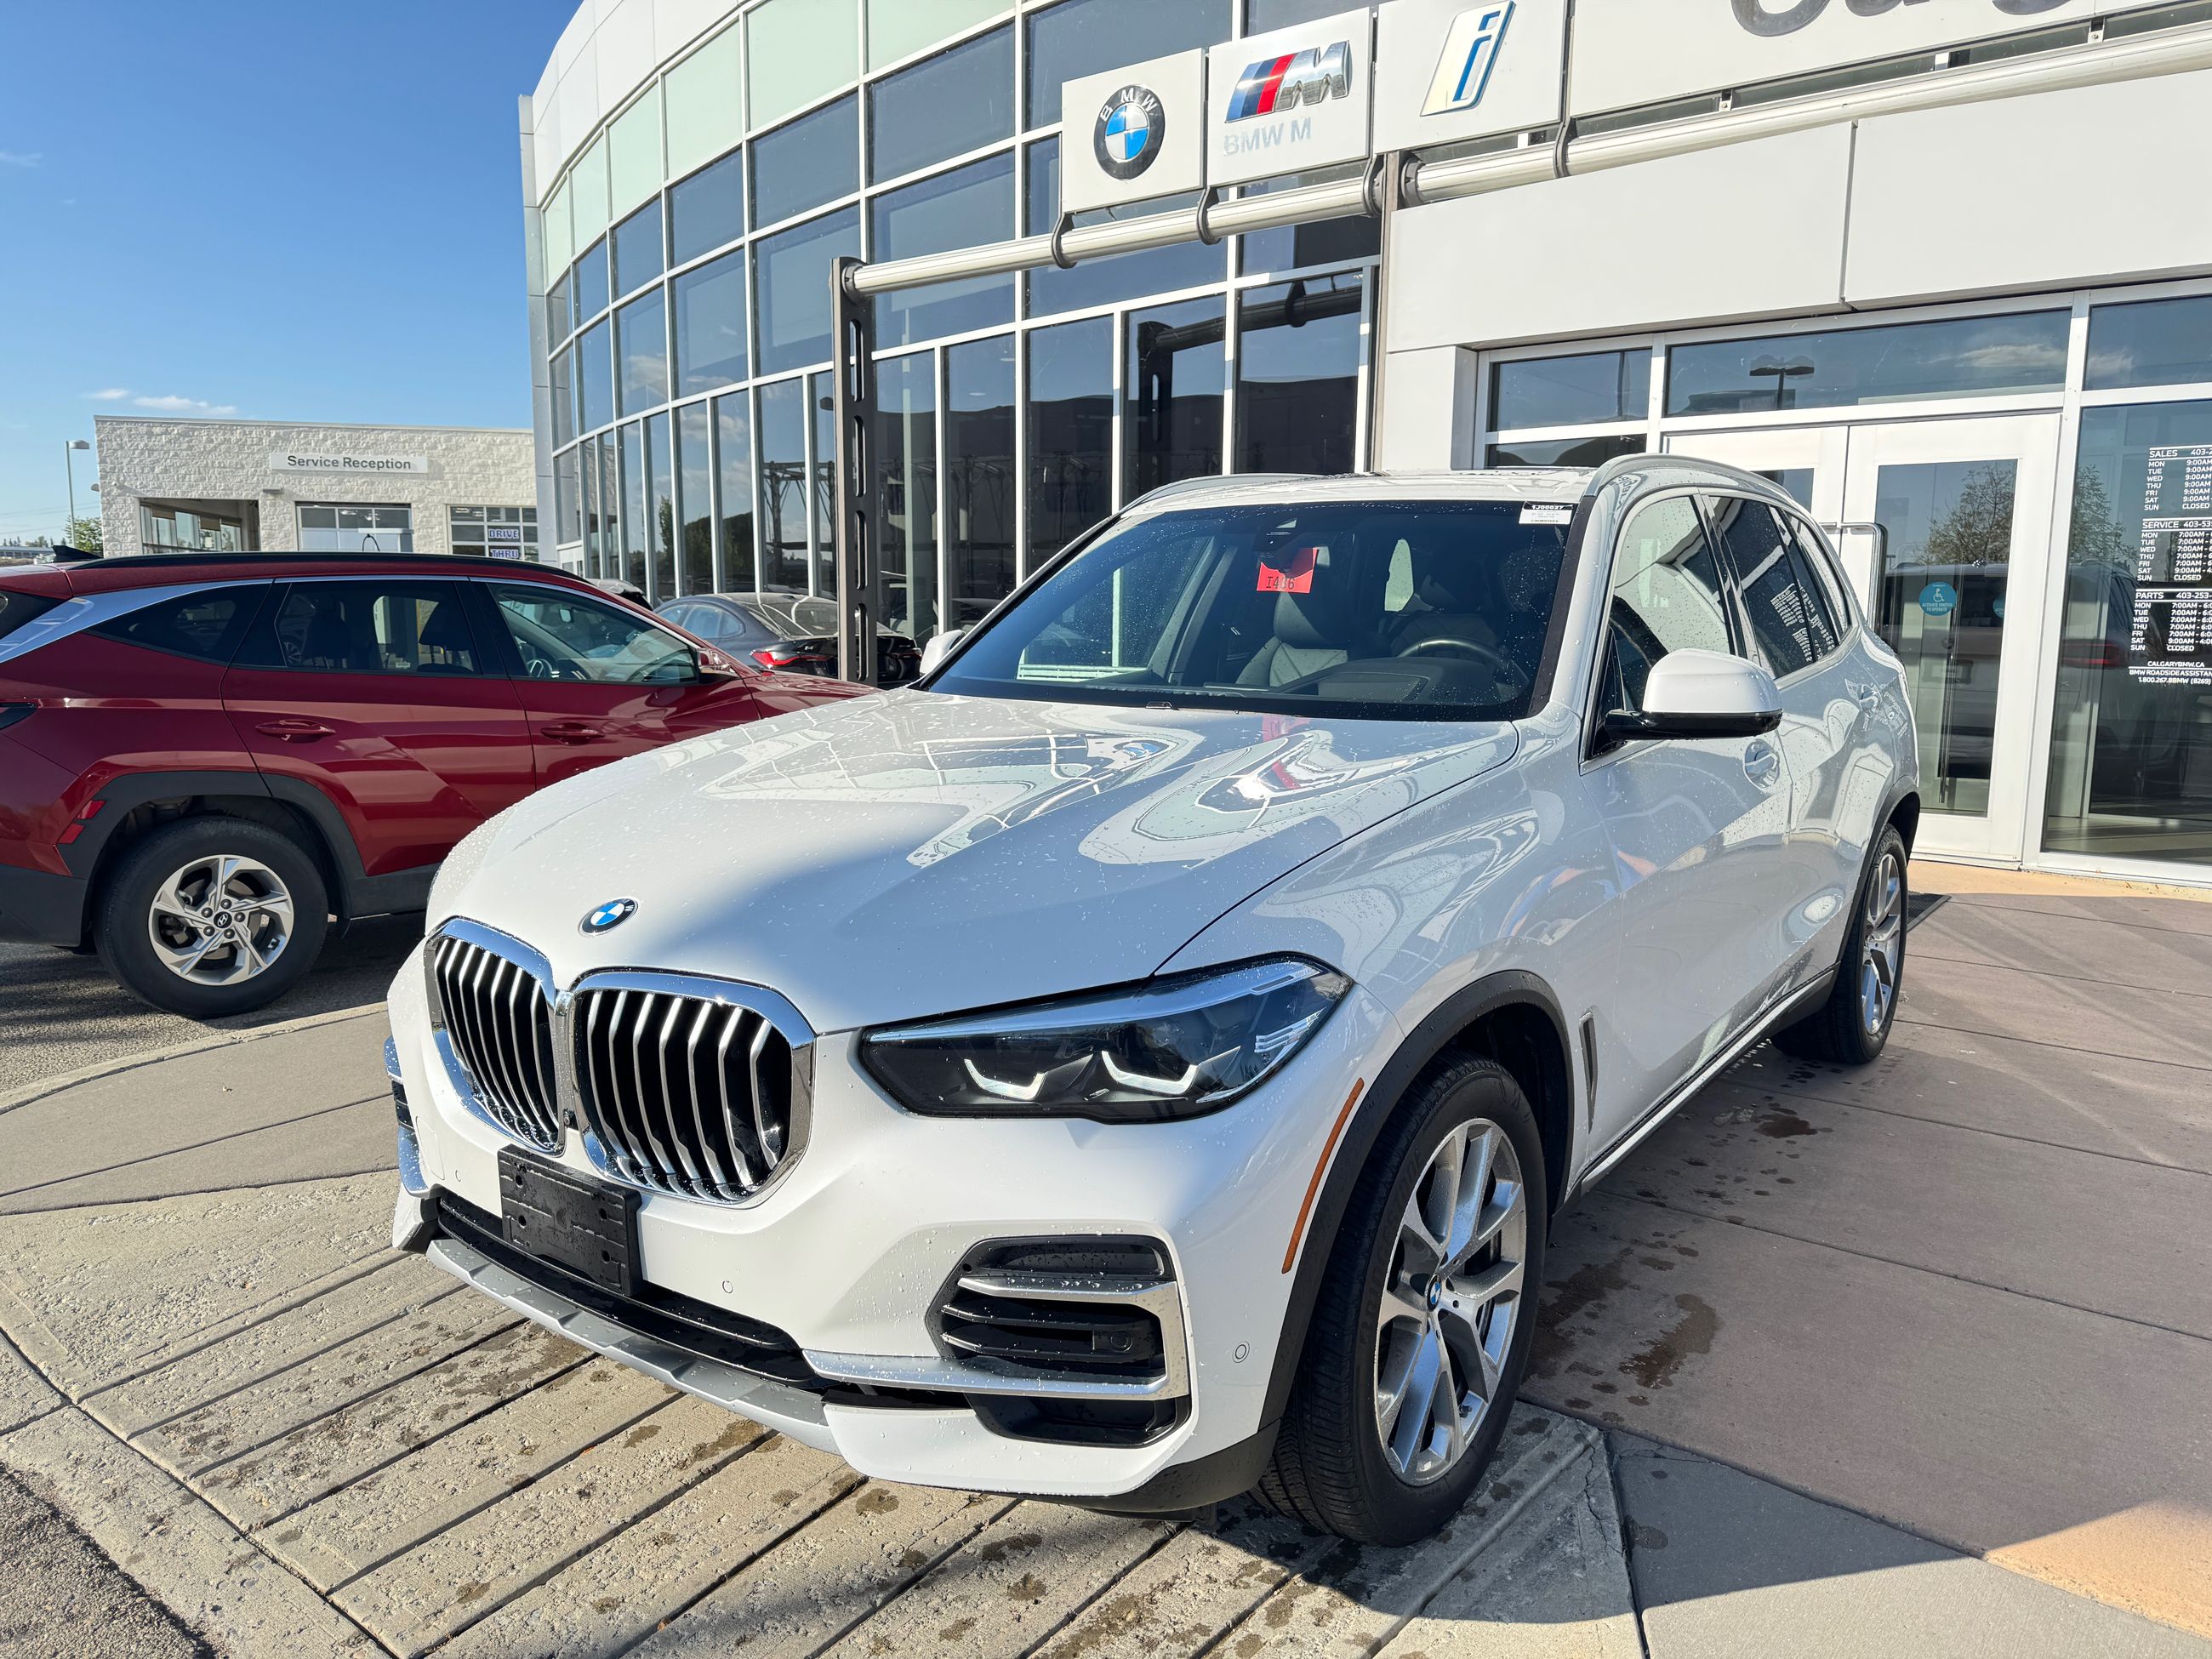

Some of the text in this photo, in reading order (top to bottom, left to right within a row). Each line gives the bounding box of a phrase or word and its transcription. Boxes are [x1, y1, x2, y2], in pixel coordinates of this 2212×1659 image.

[1100, 88, 1158, 122] BMW
[1223, 117, 1311, 157] BMW M
[288, 455, 411, 470] Service Reception
[489, 529, 519, 539] DRIVE
[491, 550, 519, 559] THRU
